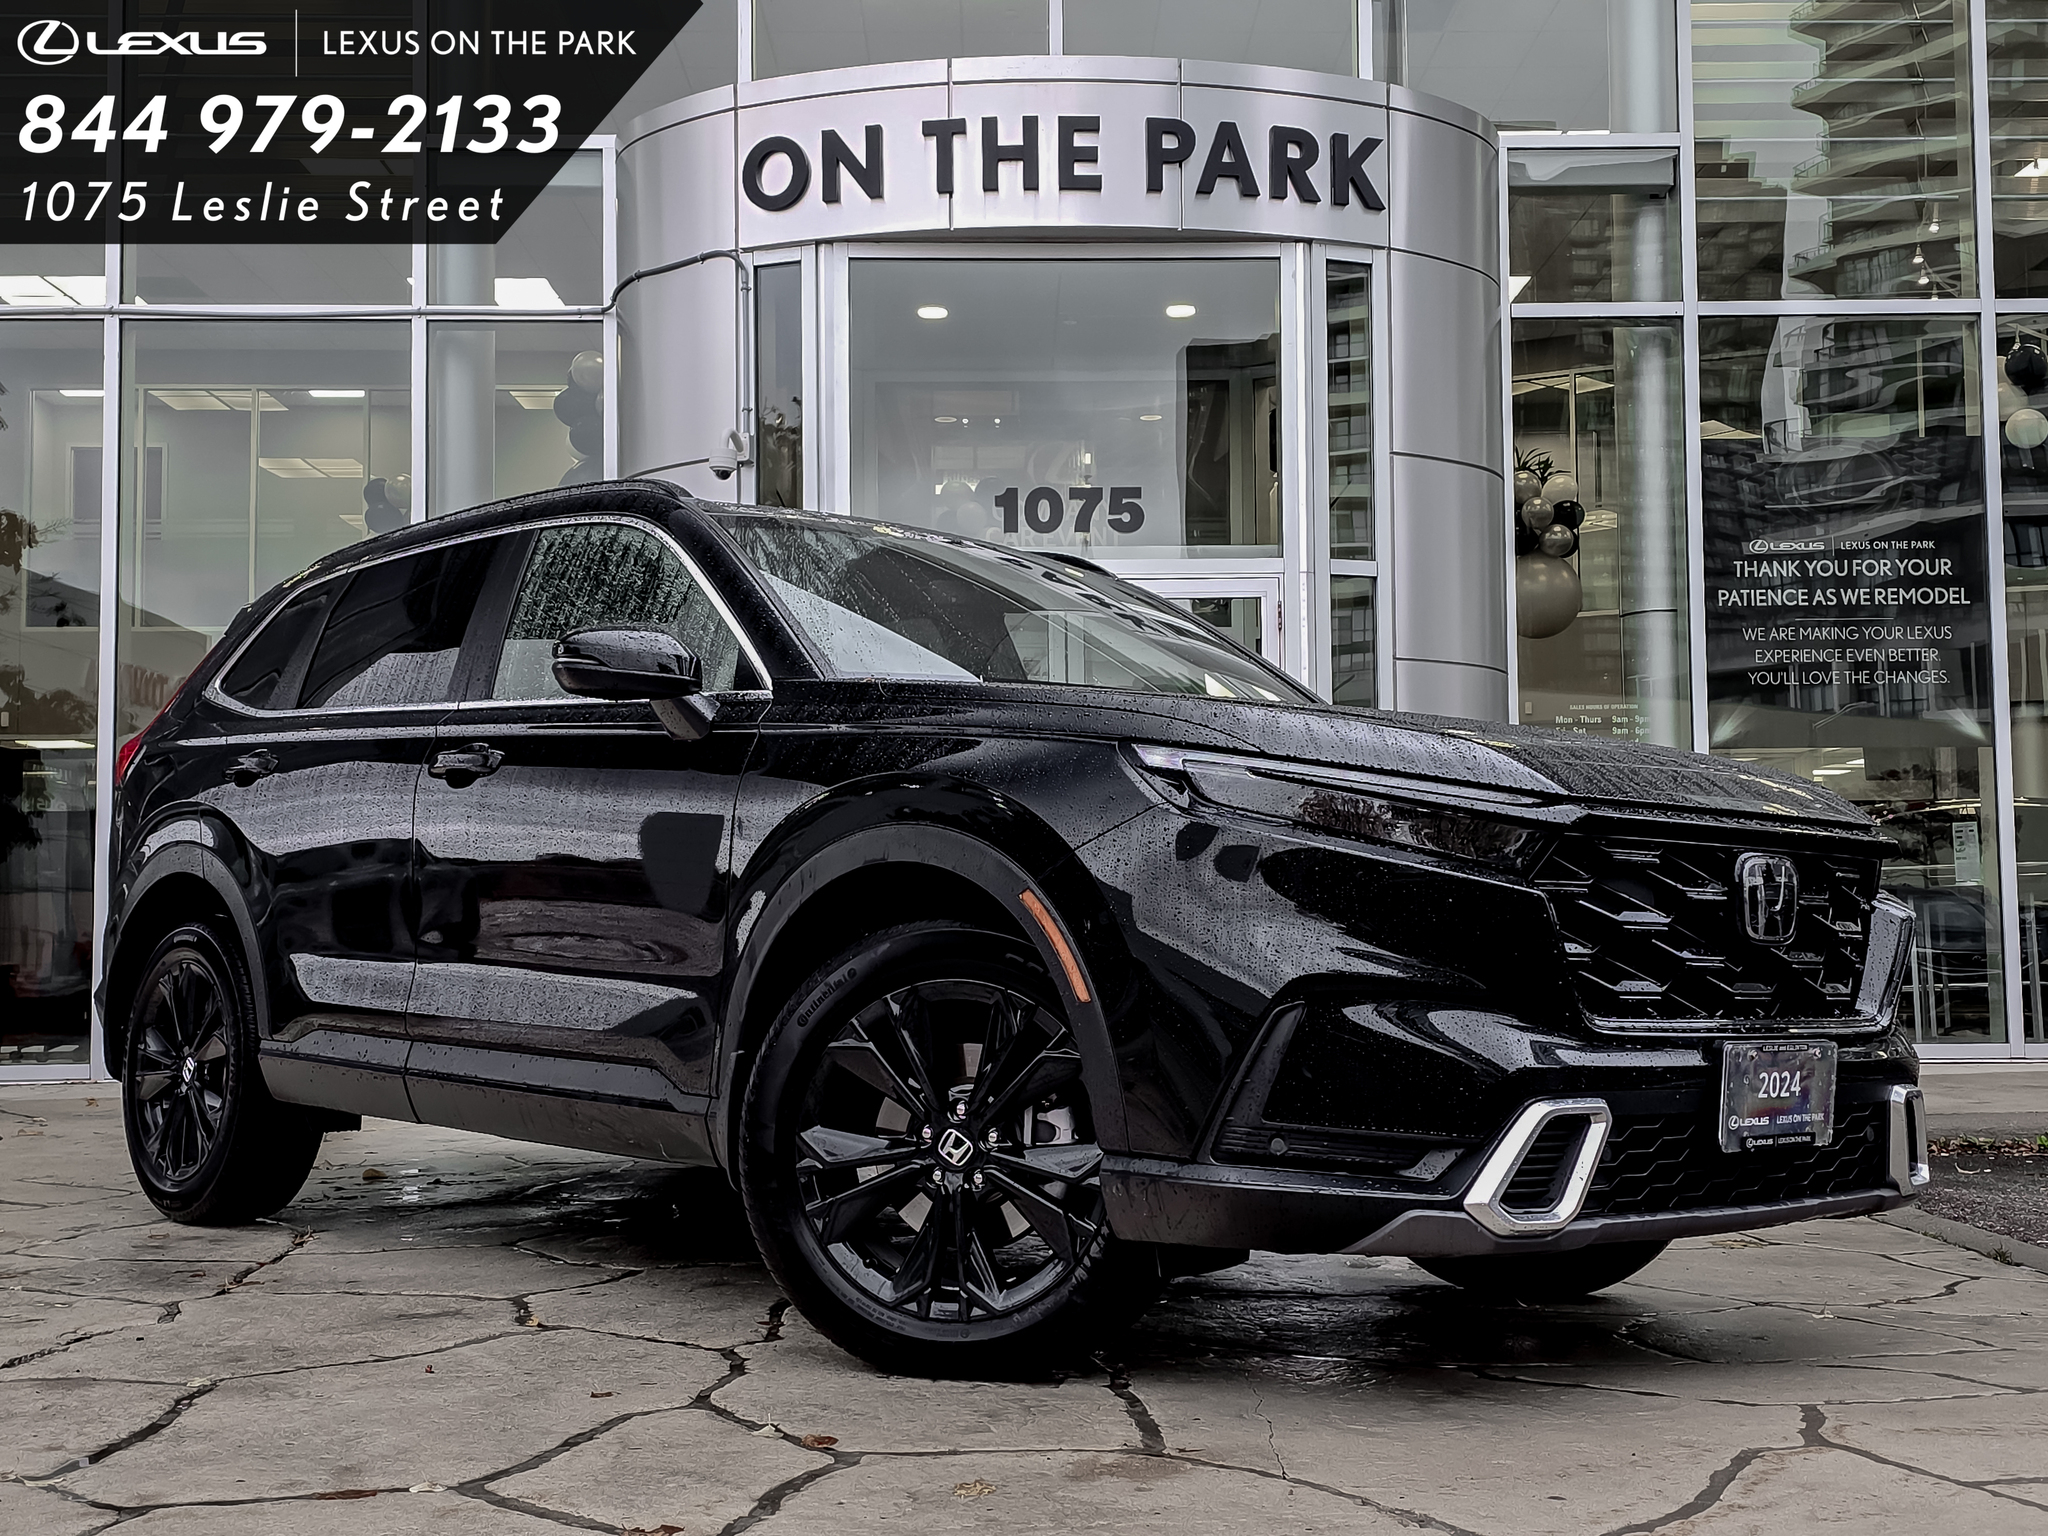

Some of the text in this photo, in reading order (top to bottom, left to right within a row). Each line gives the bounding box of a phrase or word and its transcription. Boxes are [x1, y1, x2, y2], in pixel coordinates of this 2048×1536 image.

[742, 115, 1387, 212] ON THE PARK
[994, 486, 1146, 534] 1075
[1770, 541, 1825, 551] LEXUS
[1840, 540, 1936, 550] LEXUS ON THE PARK
[1733, 558, 1953, 578] THANK YOU FOR YOUR
[1718, 587, 1971, 606] PATIENCE AS WE REMODEL
[1742, 625, 1953, 641] WE ARE MAKING YOUR LEXUS
[1755, 648, 1941, 663] EXPERIENCE EVEN BETTER.
[1748, 670, 1951, 685] YOU'LL LOVE THE CHANGES.
[1555, 715, 1573, 724] Mon
[1580, 715, 1602, 724] Thurs
[1612, 715, 1628, 723] 9am
[1612, 727, 1629, 735] 9am
[1758, 1071, 1801, 1098] 2024
[1740, 1116, 1770, 1127] LEXUS
